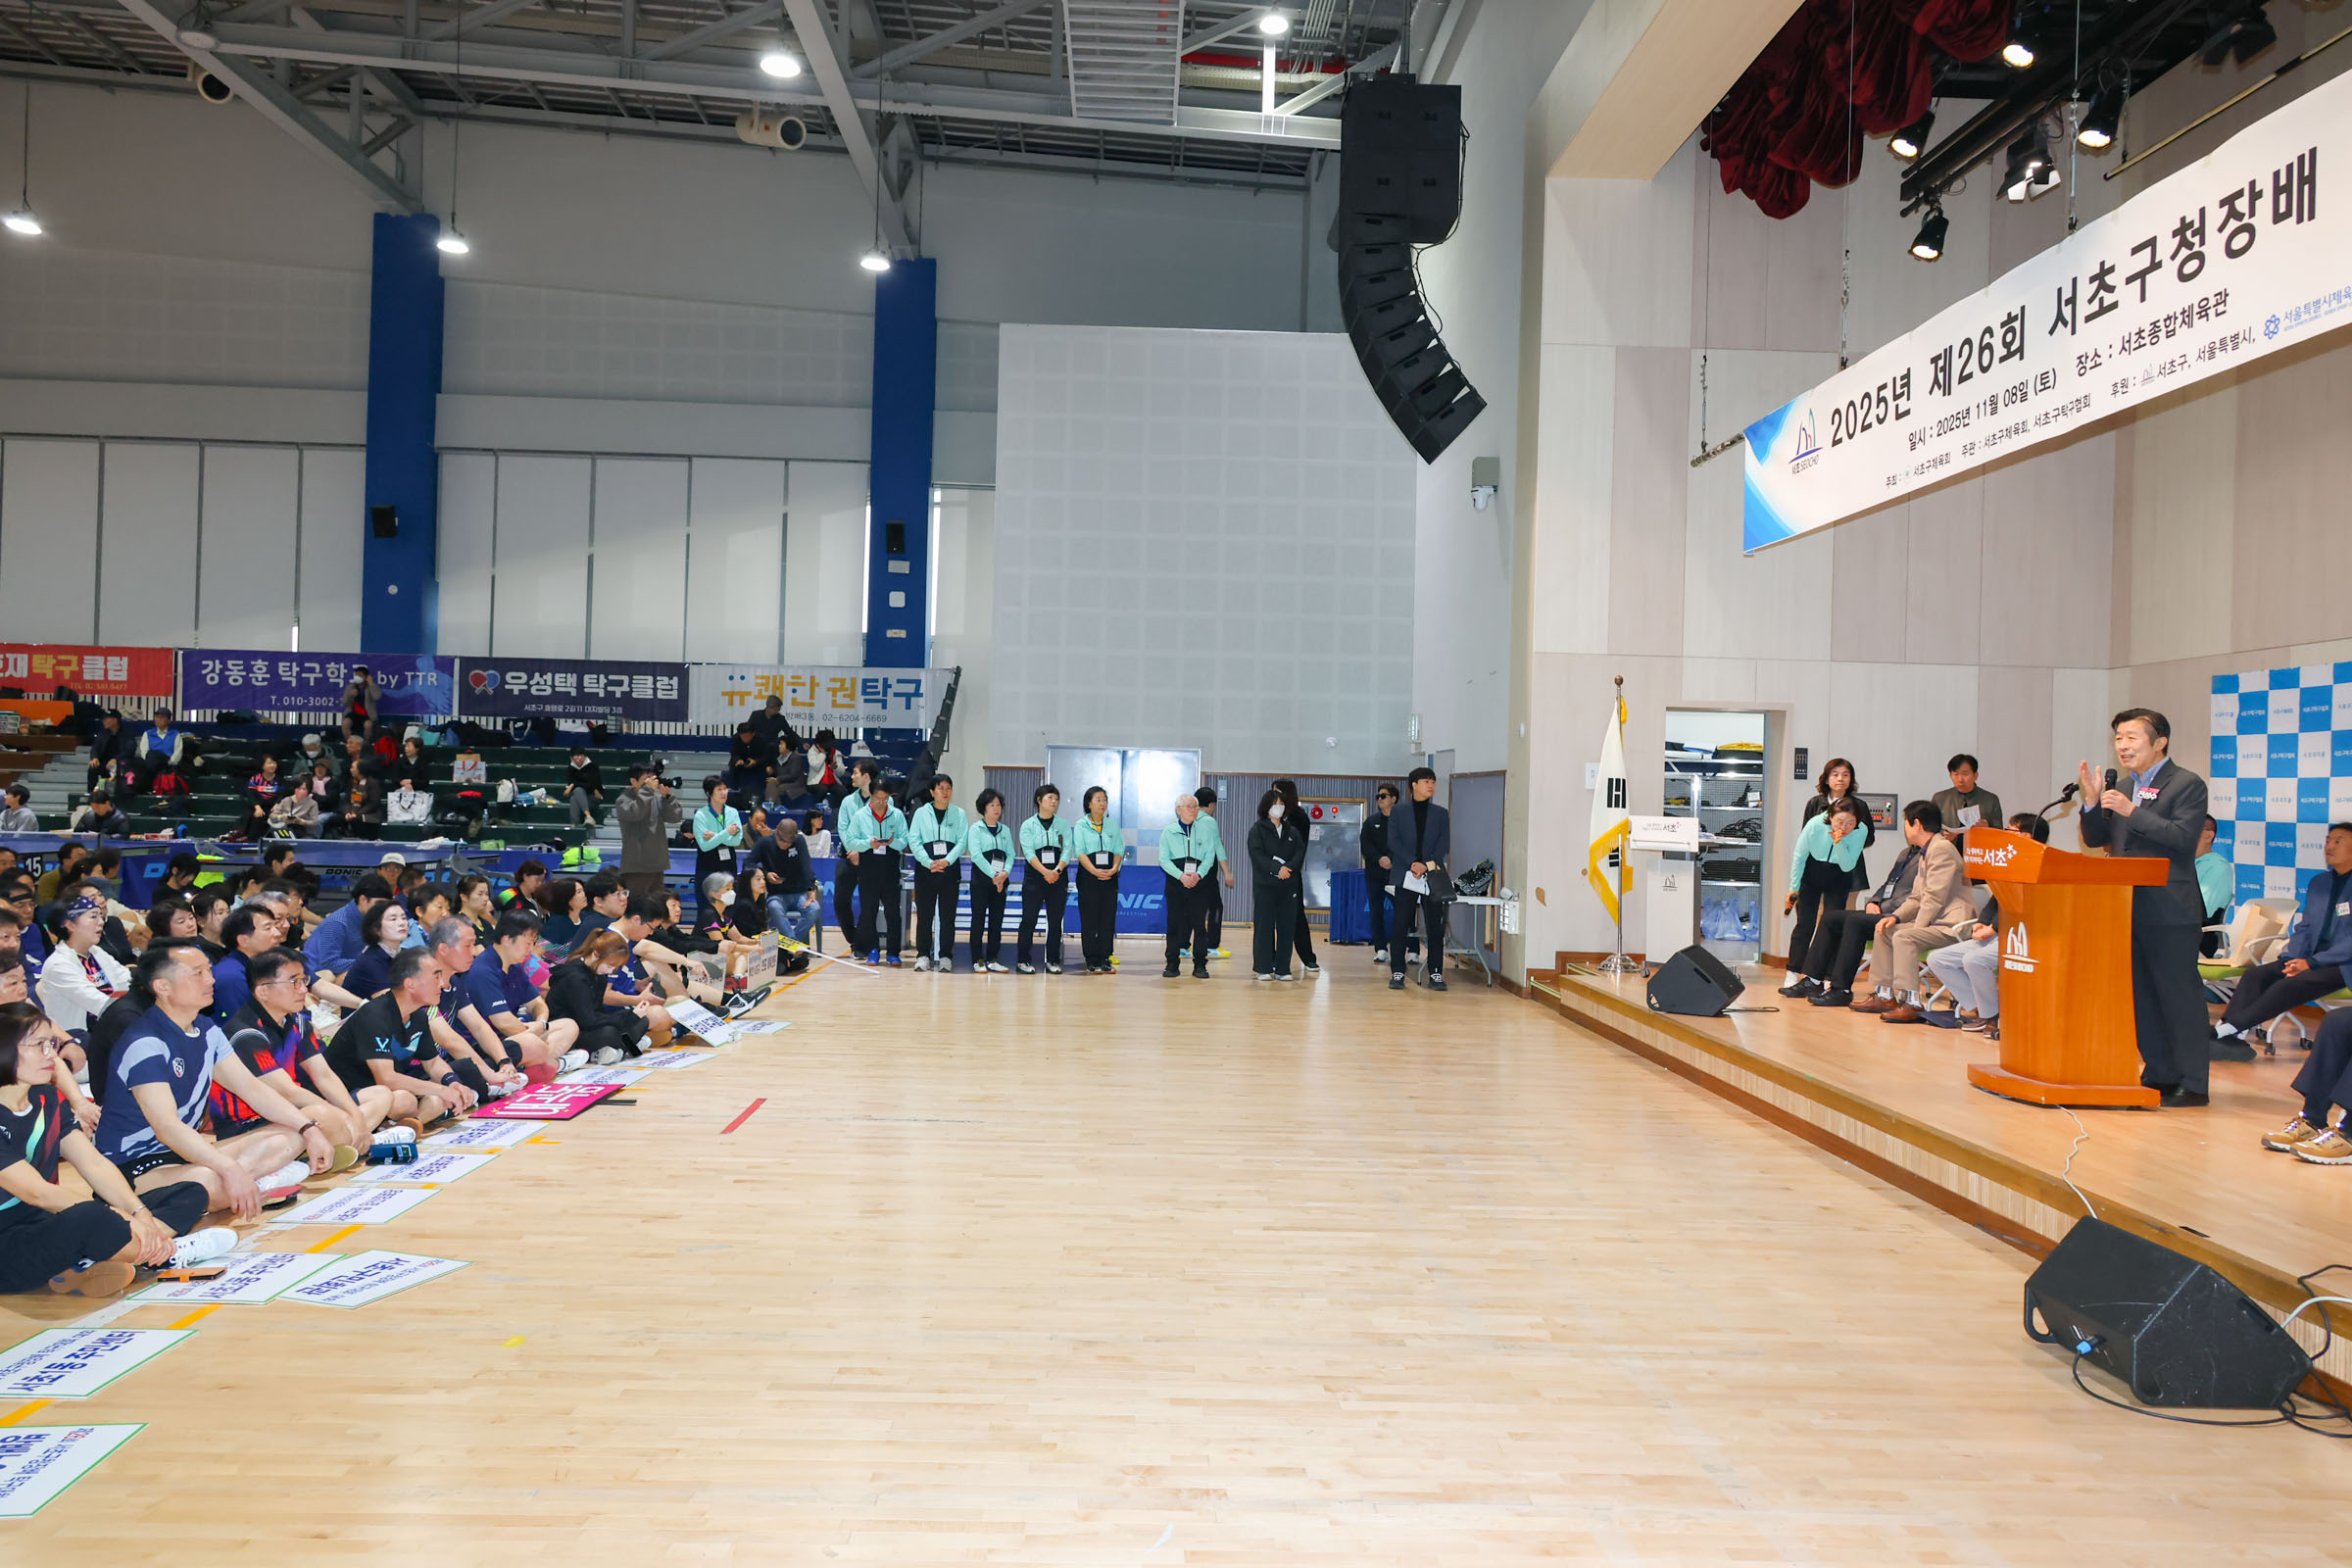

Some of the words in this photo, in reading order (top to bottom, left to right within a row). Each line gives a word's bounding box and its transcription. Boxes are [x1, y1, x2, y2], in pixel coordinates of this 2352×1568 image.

[1832, 368, 1912, 448] 2025년
[1929, 304, 2027, 398] 제26회
[2048, 146, 2319, 337] 서초구청장배
[1908, 426, 1926, 452] 일시
[1936, 406, 1971, 437] 2025년
[1976, 393, 1998, 419] 11월
[2003, 379, 2030, 409] 08일
[2034, 368, 2058, 396] (토)
[2076, 348, 2102, 377] 장소
[2119, 288, 2230, 357] 서초종합체육관
[1886, 474, 1898, 489] 주최
[1913, 451, 1951, 477] 서초구체육회
[1961, 441, 1977, 459] 주관
[2033, 393, 2091, 428] 서초구탁구협회
[2111, 377, 2130, 399] 후원
[2156, 355, 2191, 379] 서초구,
[2195, 325, 2256, 366] 서울특별시,
[32, 655, 79, 679] 탁구
[82, 656, 128, 681] 클럽
[201, 660, 271, 686] 강동훈
[377, 670, 399, 688] by
[404, 672, 438, 687] TTR
[505, 671, 577, 697] 우성택
[583, 674, 679, 700] 탁구클럽
[523, 703, 544, 712] 서초구
[822, 713, 888, 723] 02-6204-6669
[1662, 823, 1677, 833] 서초
[25, 856, 42, 877] 15
[1984, 848, 2008, 866] 서초
[495, 1085, 606, 1116] 내곡동
[296, 1257, 412, 1298] 서초구민회관
[8, 1362, 87, 1392] 서초1동
[64, 1331, 147, 1360] 주민센터
